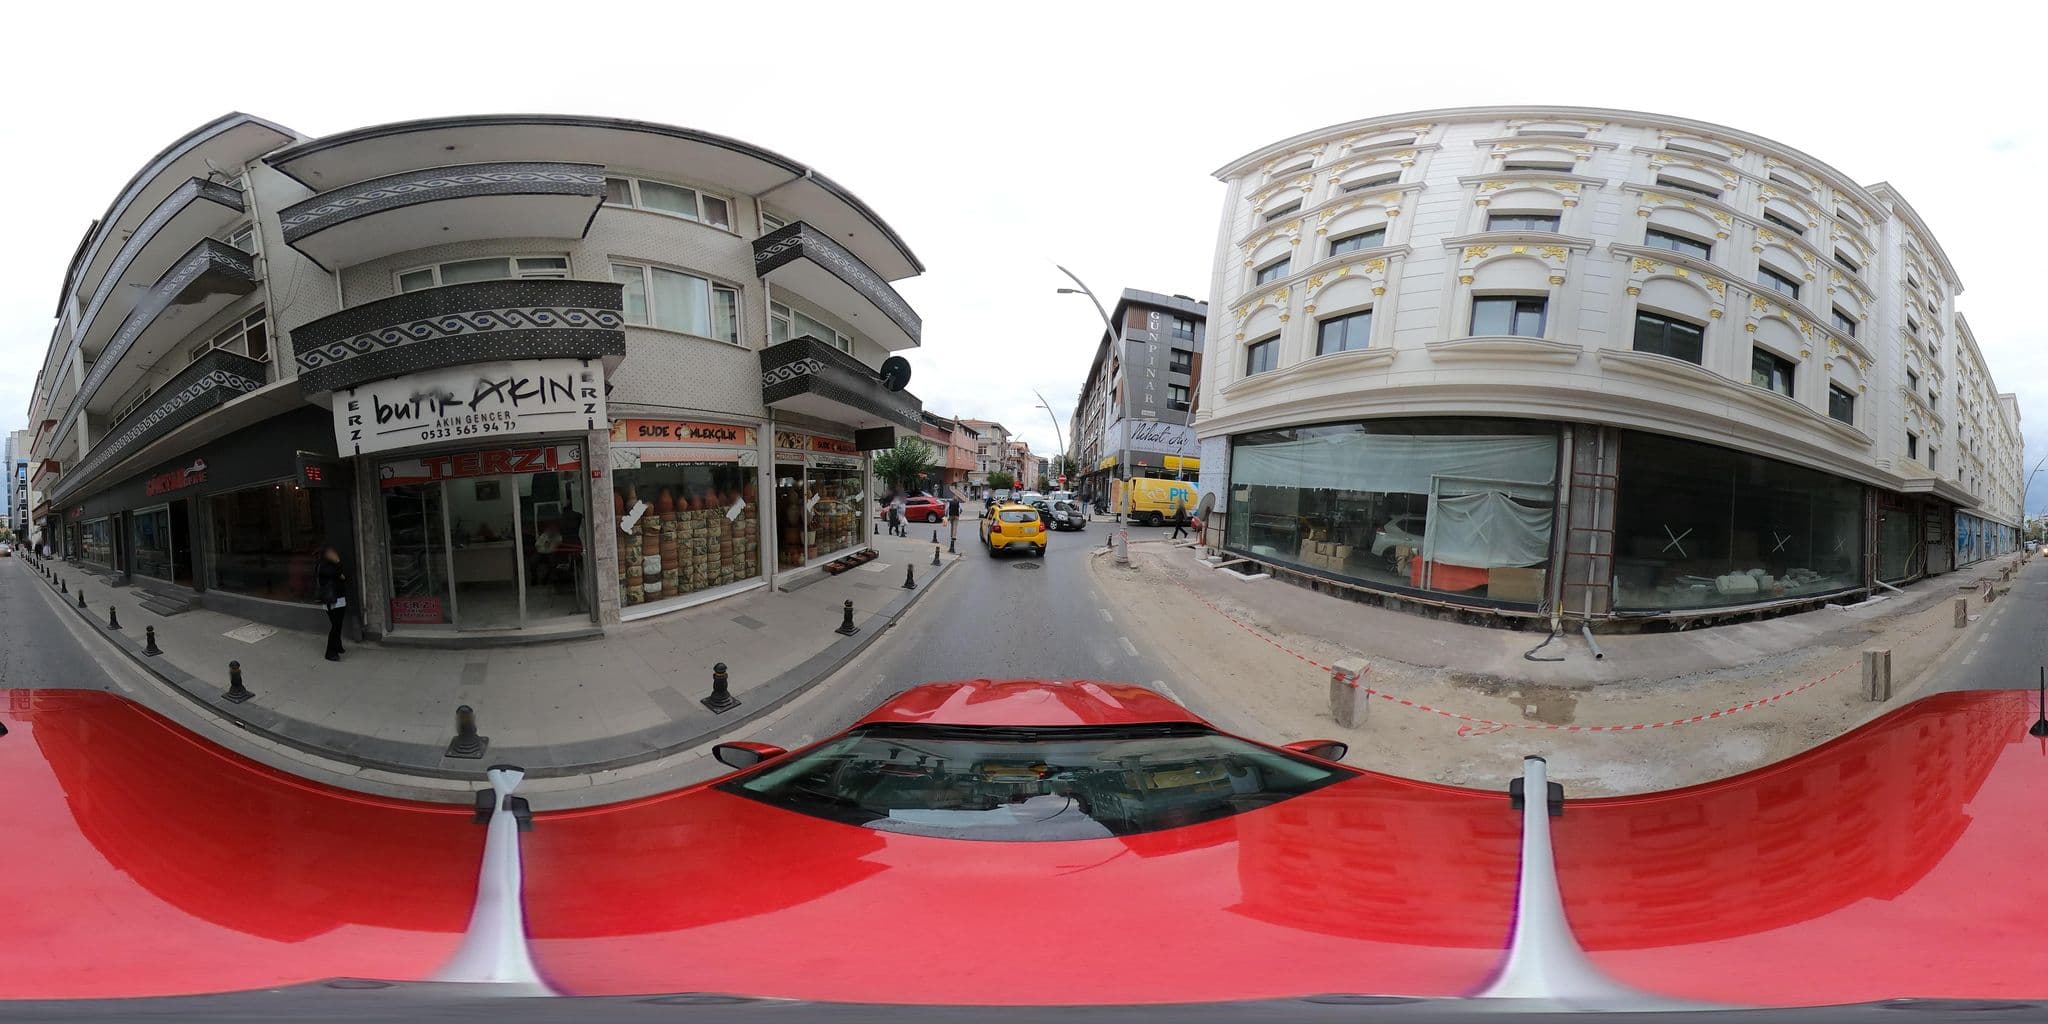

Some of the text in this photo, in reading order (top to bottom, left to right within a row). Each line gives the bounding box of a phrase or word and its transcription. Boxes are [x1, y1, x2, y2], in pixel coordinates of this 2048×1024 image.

[1145, 311, 1160, 404] GÜNPINAR
[468, 374, 576, 412] AKIN
[436, 410, 511, 428] AKIN GENCER
[421, 428, 451, 440] 0533
[456, 424, 478, 435] 565
[483, 422, 499, 432] 94
[638, 425, 670, 437] SUDE
